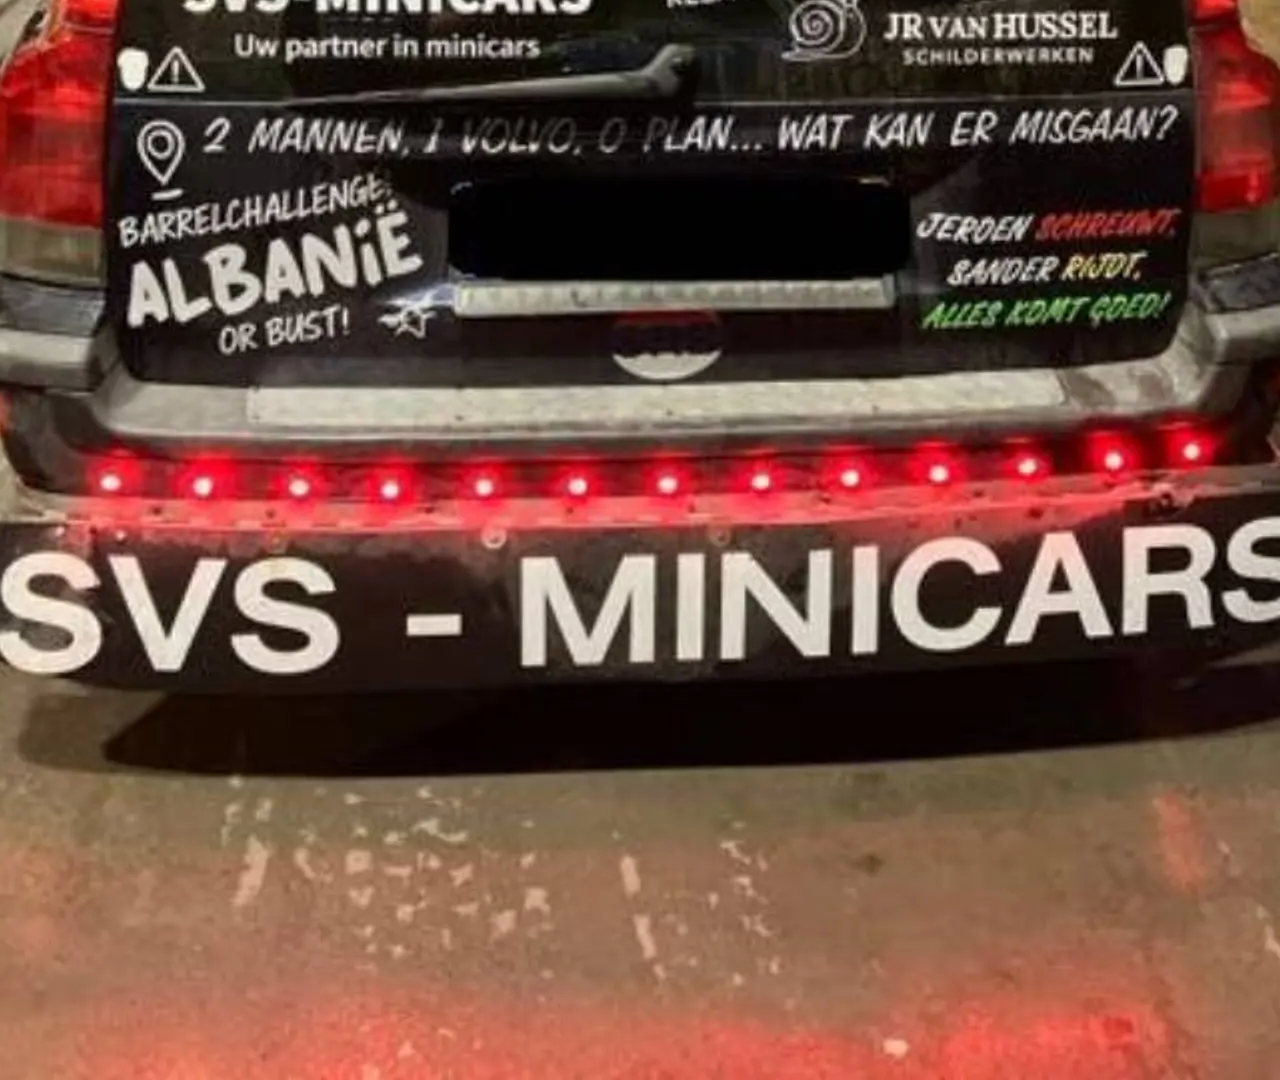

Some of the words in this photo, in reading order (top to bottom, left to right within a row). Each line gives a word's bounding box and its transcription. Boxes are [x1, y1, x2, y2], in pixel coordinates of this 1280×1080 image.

[883, 12, 923, 40] JR
[927, 16, 987, 39] VAN
[992, 11, 1118, 39] HUSSEL
[234, 34, 276, 58] Uw
[285, 34, 387, 64] partner
[394, 33, 418, 58] in
[425, 33, 541, 59] minicars
[903, 47, 1094, 65] SCHILDERWERKEN
[202, 116, 230, 153] 2
[248, 117, 410, 159] MANNEN,
[643, 115, 764, 153] PLAN...
[777, 114, 854, 151] WAT
[863, 113, 936, 149] KAN
[950, 109, 1000, 147] ER
[1008, 103, 1179, 145] MISGAAN?
[915, 212, 1036, 245] JEROEN
[946, 256, 1060, 286] SANDER
[920, 300, 1005, 330] ALLES
[1006, 296, 1091, 326] KOMT
[1088, 291, 1172, 328] GOED!
[219, 323, 258, 355] OR
[265, 305, 351, 347] BUST!
